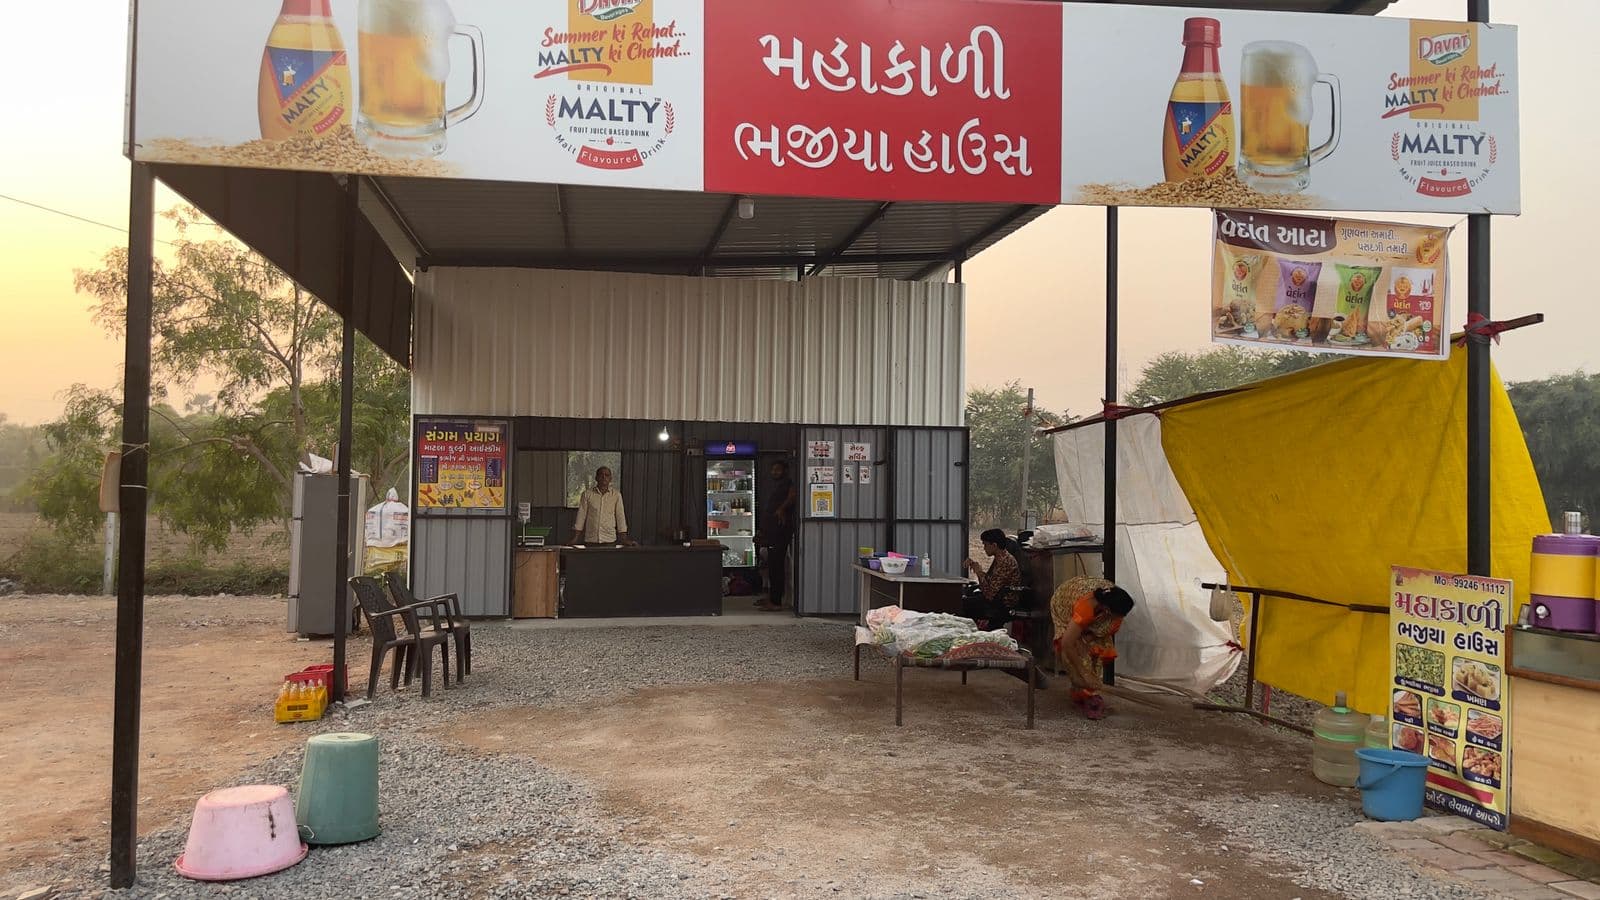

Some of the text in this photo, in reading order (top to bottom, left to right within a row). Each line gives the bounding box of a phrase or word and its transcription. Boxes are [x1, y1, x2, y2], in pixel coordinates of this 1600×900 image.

[541, 19, 686, 48] Summer ki Rahat...
[1418, 33, 1469, 59] DAVAT
[538, 39, 691, 67] MALTY ki Chahat...
[758, 24, 1011, 100] મહાકાળી
[577, 84, 643, 95] ORIGINAL
[1387, 61, 1505, 91] Summer ki Rahat...
[282, 76, 328, 124] MALTY
[1385, 80, 1509, 108] MALTY ki Chahat...
[558, 96, 660, 124] MALTY
[569, 126, 649, 137] FRUIT JUICE BASED DRINK
[1401, 133, 1485, 155] MALTY
[555, 133, 666, 165] Malt Flavoured Drink
[734, 117, 1033, 176] ભજીયા હાઉસ
[1180, 125, 1217, 168] MALTY
[1399, 167, 1490, 193] Malt Flavoured Drink
[1220, 212, 1327, 248] વેદાંત આટા
[425, 426, 458, 441] સંગમ
[1454, 577, 1478, 591] 99246
[1481, 583, 1505, 595] 11112
[1394, 591, 1505, 633] મહાકાળી
[1397, 622, 1498, 656] ભજીયા હાઉસ
[1448, 798, 1474, 816] લેવામાં
